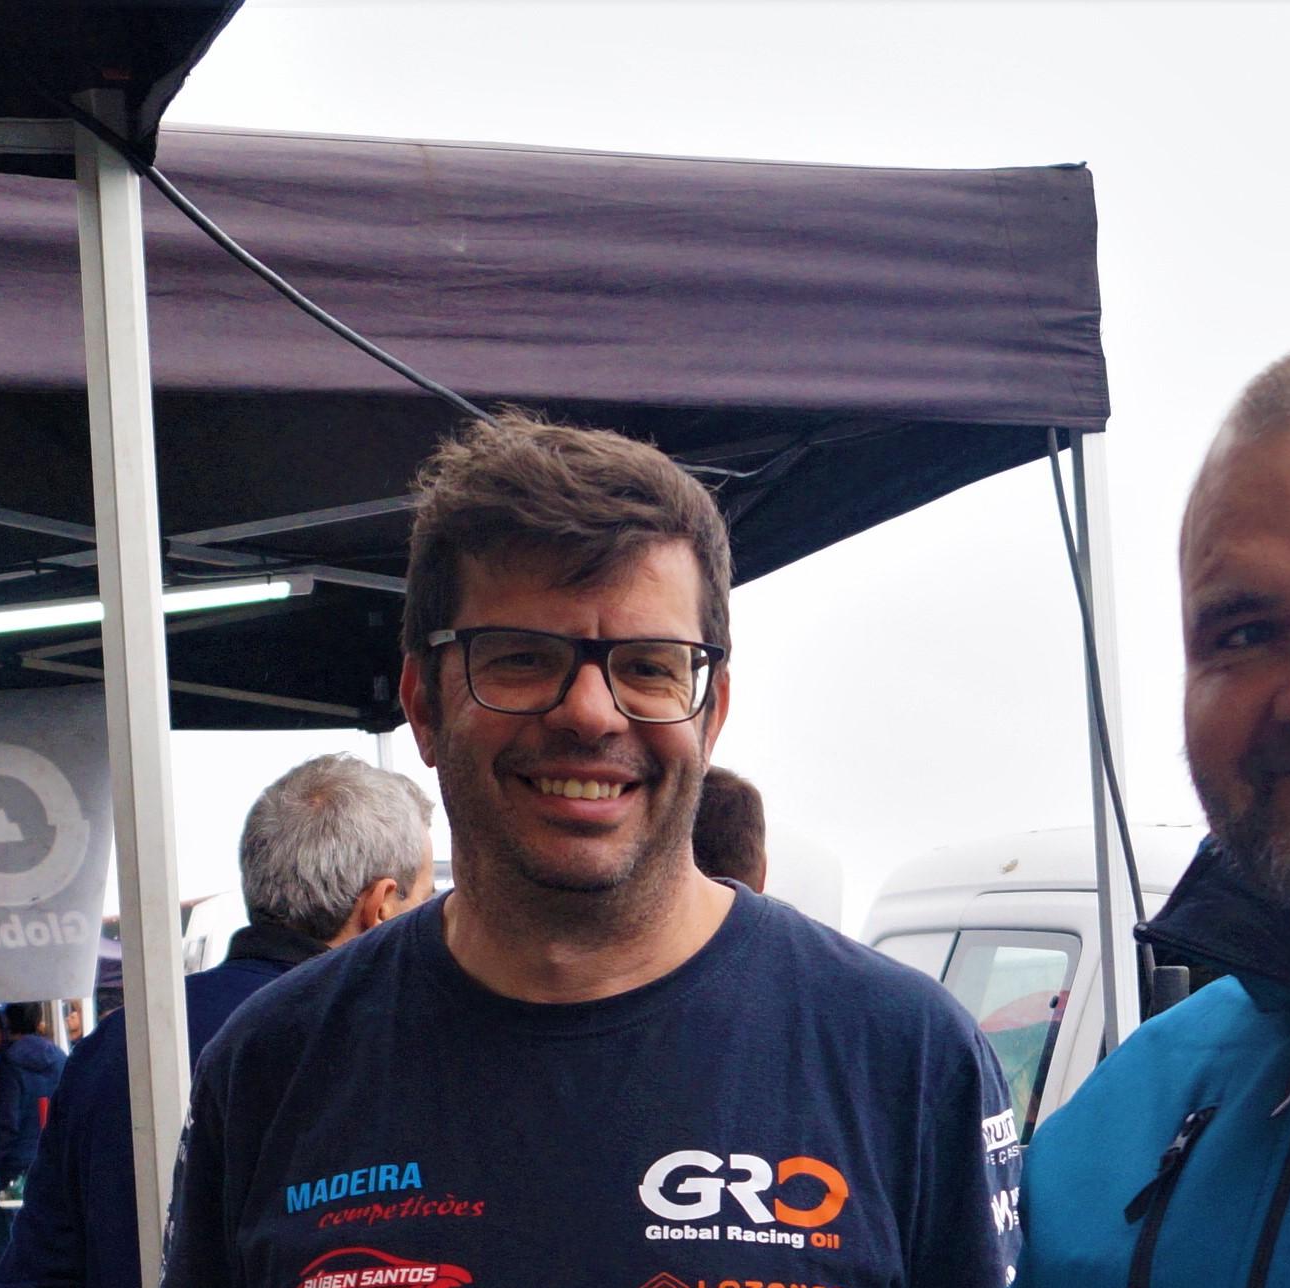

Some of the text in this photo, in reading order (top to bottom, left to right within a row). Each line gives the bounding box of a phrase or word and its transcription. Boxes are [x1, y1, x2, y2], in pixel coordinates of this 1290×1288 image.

[286, 1161, 423, 1214] MADEIRA
[645, 1223, 840, 1249] Global Racing Oil
[360, 1267, 437, 1286] SANTOS
